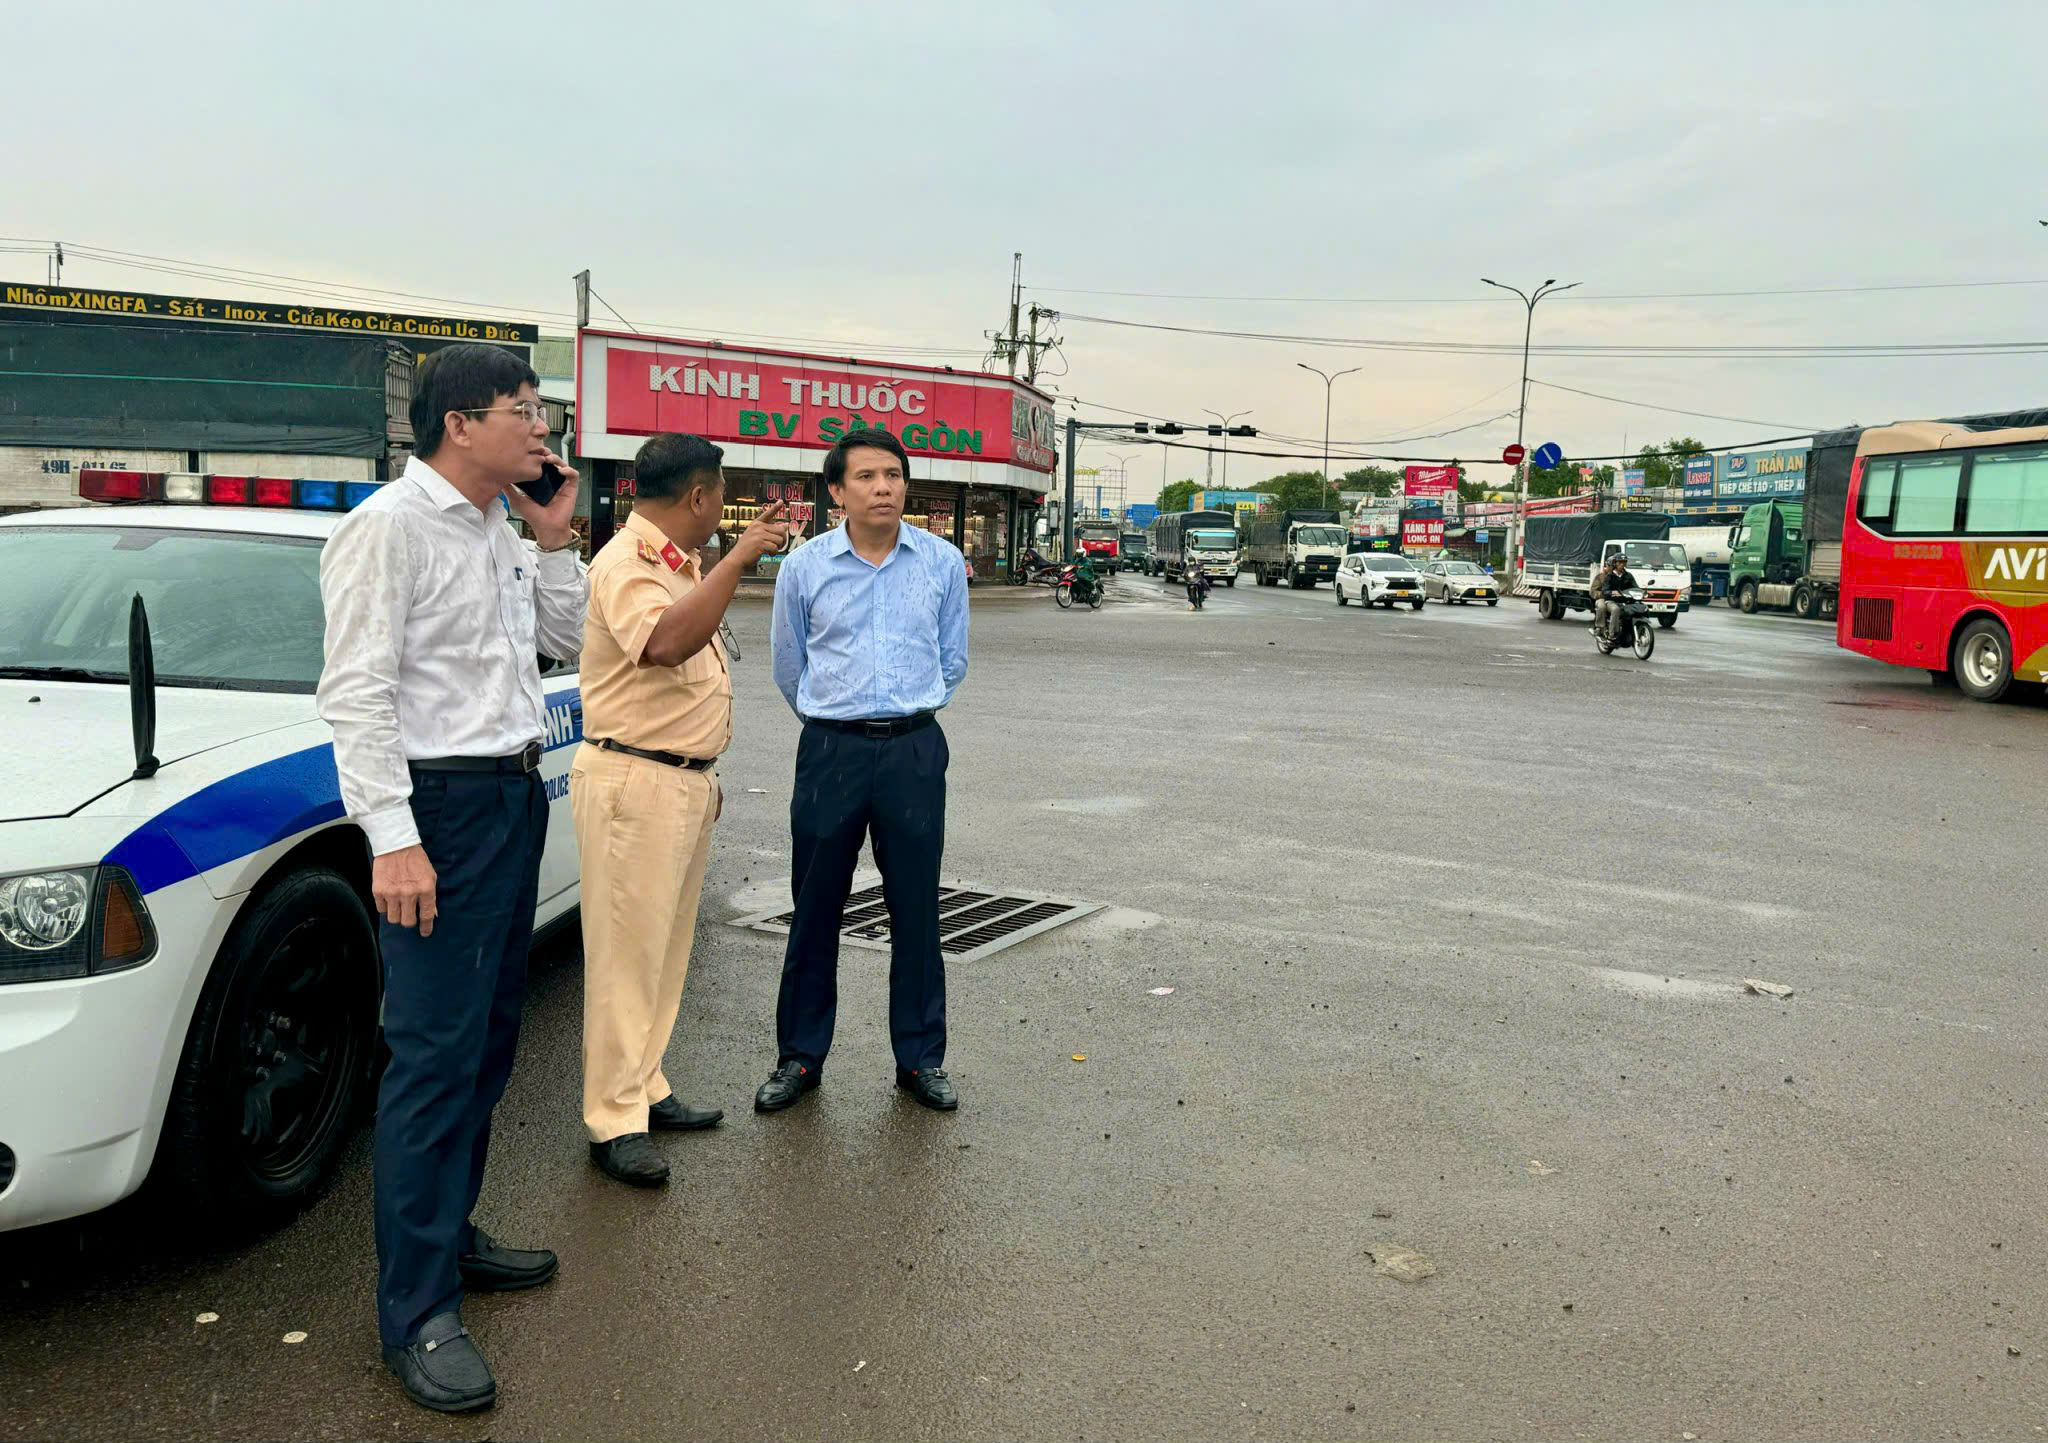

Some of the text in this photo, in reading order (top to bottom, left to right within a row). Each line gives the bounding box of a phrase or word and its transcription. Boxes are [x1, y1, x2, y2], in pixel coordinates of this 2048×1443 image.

[168, 297, 205, 317] Sắt
[225, 304, 267, 321] Inox
[485, 323, 520, 341] Đức
[650, 361, 926, 415] KÍNH THUỐC
[739, 410, 801, 438] BV
[902, 420, 983, 454] GÒN
[41, 460, 71, 473] 49H
[1755, 449, 1784, 473] TRẦN
[1787, 456, 1804, 471] AN
[1688, 471, 1712, 485] Laser
[1719, 481, 1737, 495] THÉP
[1738, 477, 1753, 494] CHẾ
[1753, 480, 1769, 496] TẠO
[1775, 476, 1795, 492] THÉP
[789, 502, 813, 521] VIÊN
[1407, 535, 1441, 543] LONG AN
[545, 773, 569, 802] POLICE
